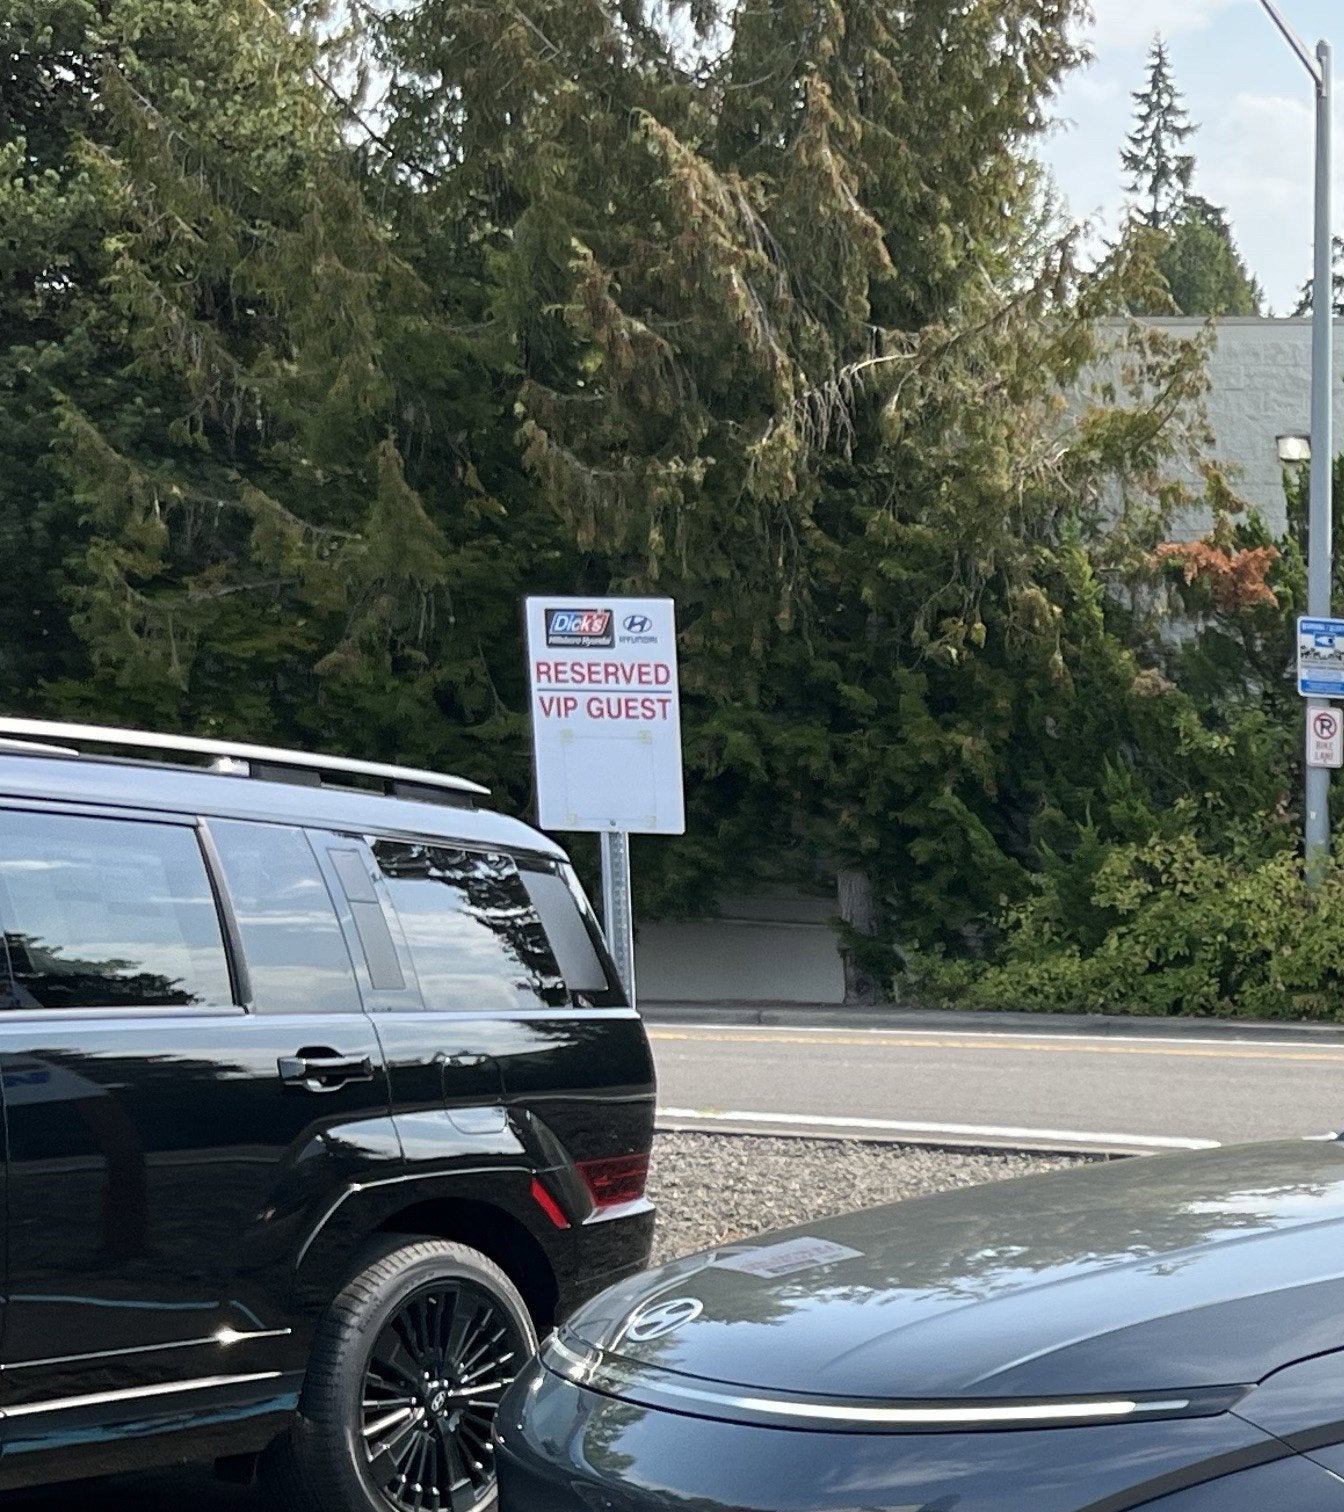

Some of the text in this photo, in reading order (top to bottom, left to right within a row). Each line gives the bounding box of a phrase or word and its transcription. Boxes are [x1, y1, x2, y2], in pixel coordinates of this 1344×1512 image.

[535, 661, 670, 686] RESERVED
[538, 696, 672, 721] VIP GUEST
